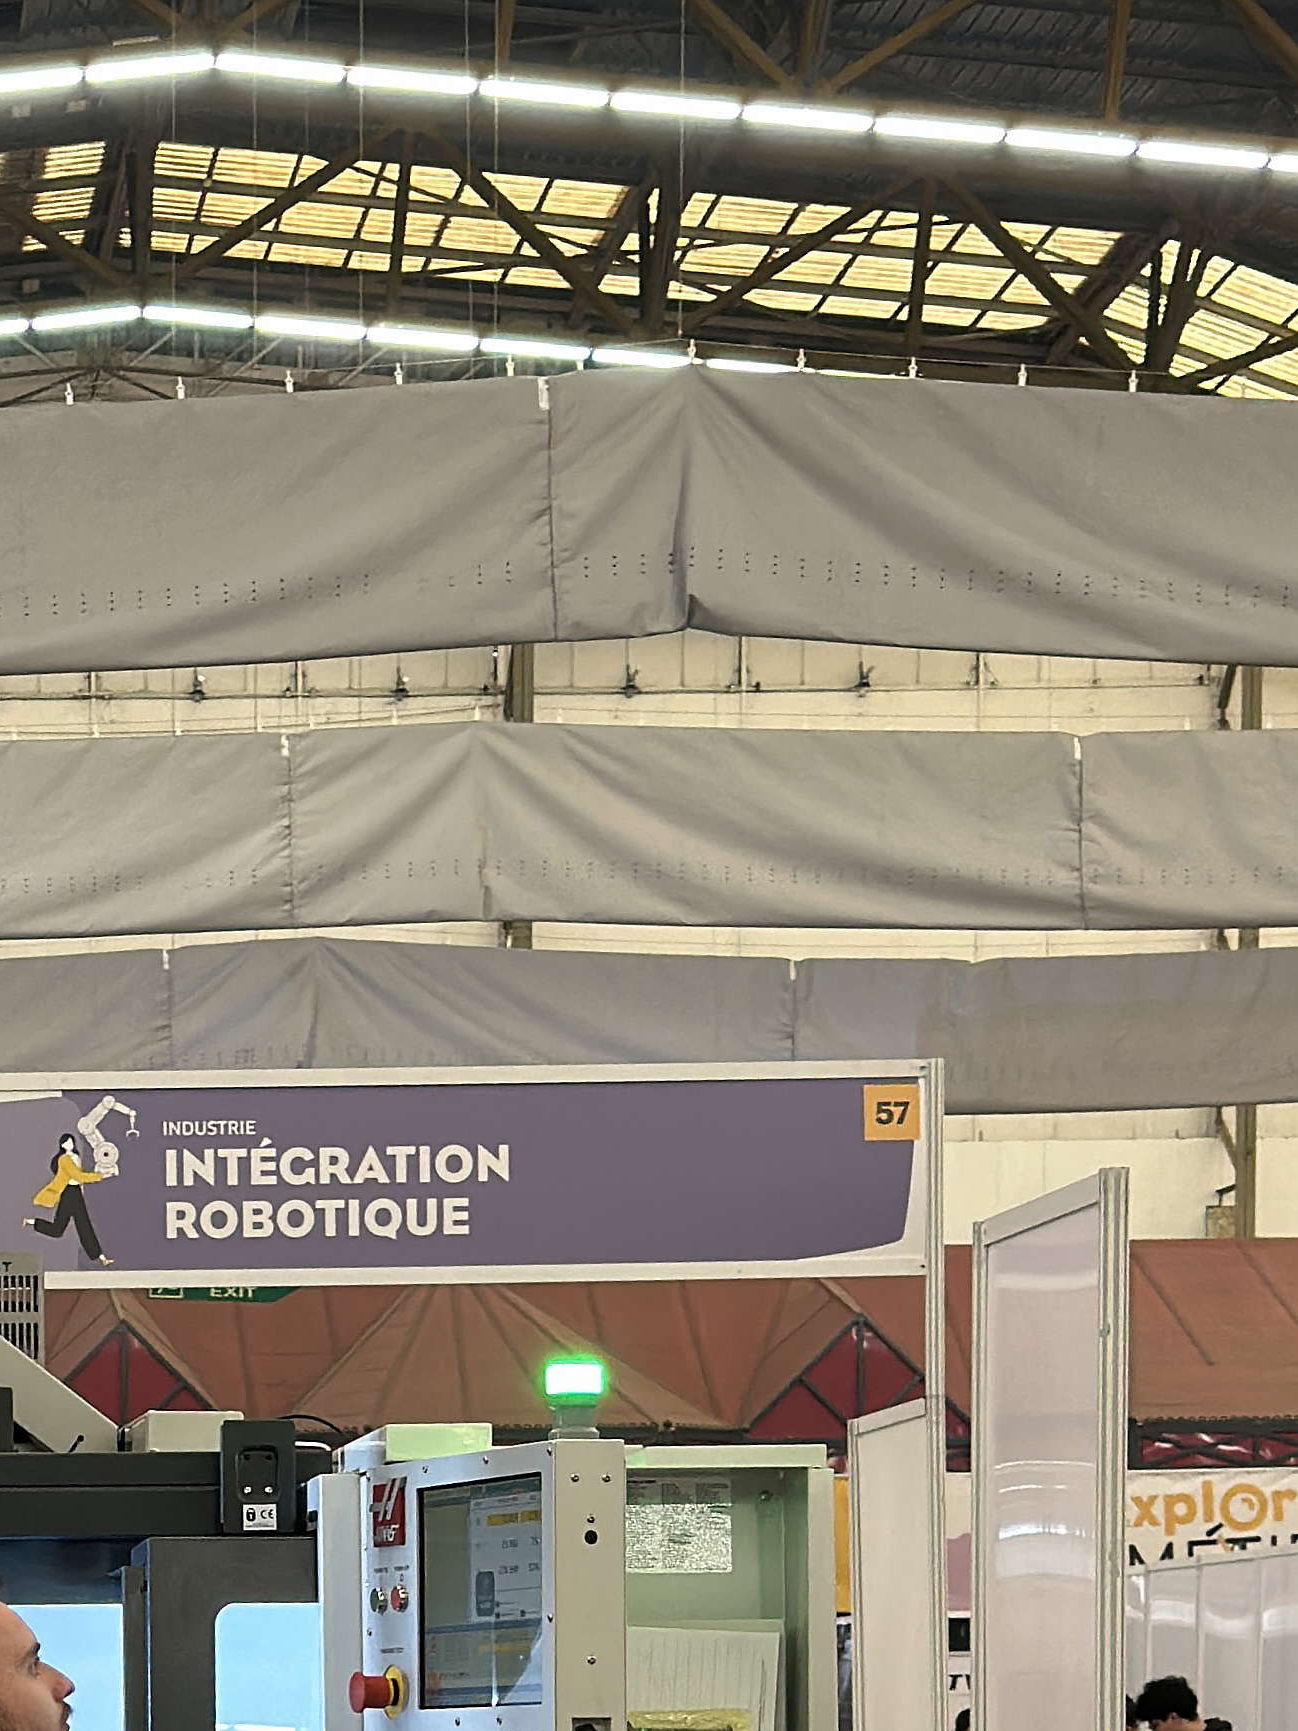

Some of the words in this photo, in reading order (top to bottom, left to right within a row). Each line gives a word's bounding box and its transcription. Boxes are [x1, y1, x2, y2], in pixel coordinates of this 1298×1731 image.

[162, 1119, 256, 1136] INDUSTRIE
[875, 1101, 910, 1125] 57
[165, 1136, 510, 1187] INTÉGRATION
[166, 1197, 470, 1240] ROBOTIQUE
